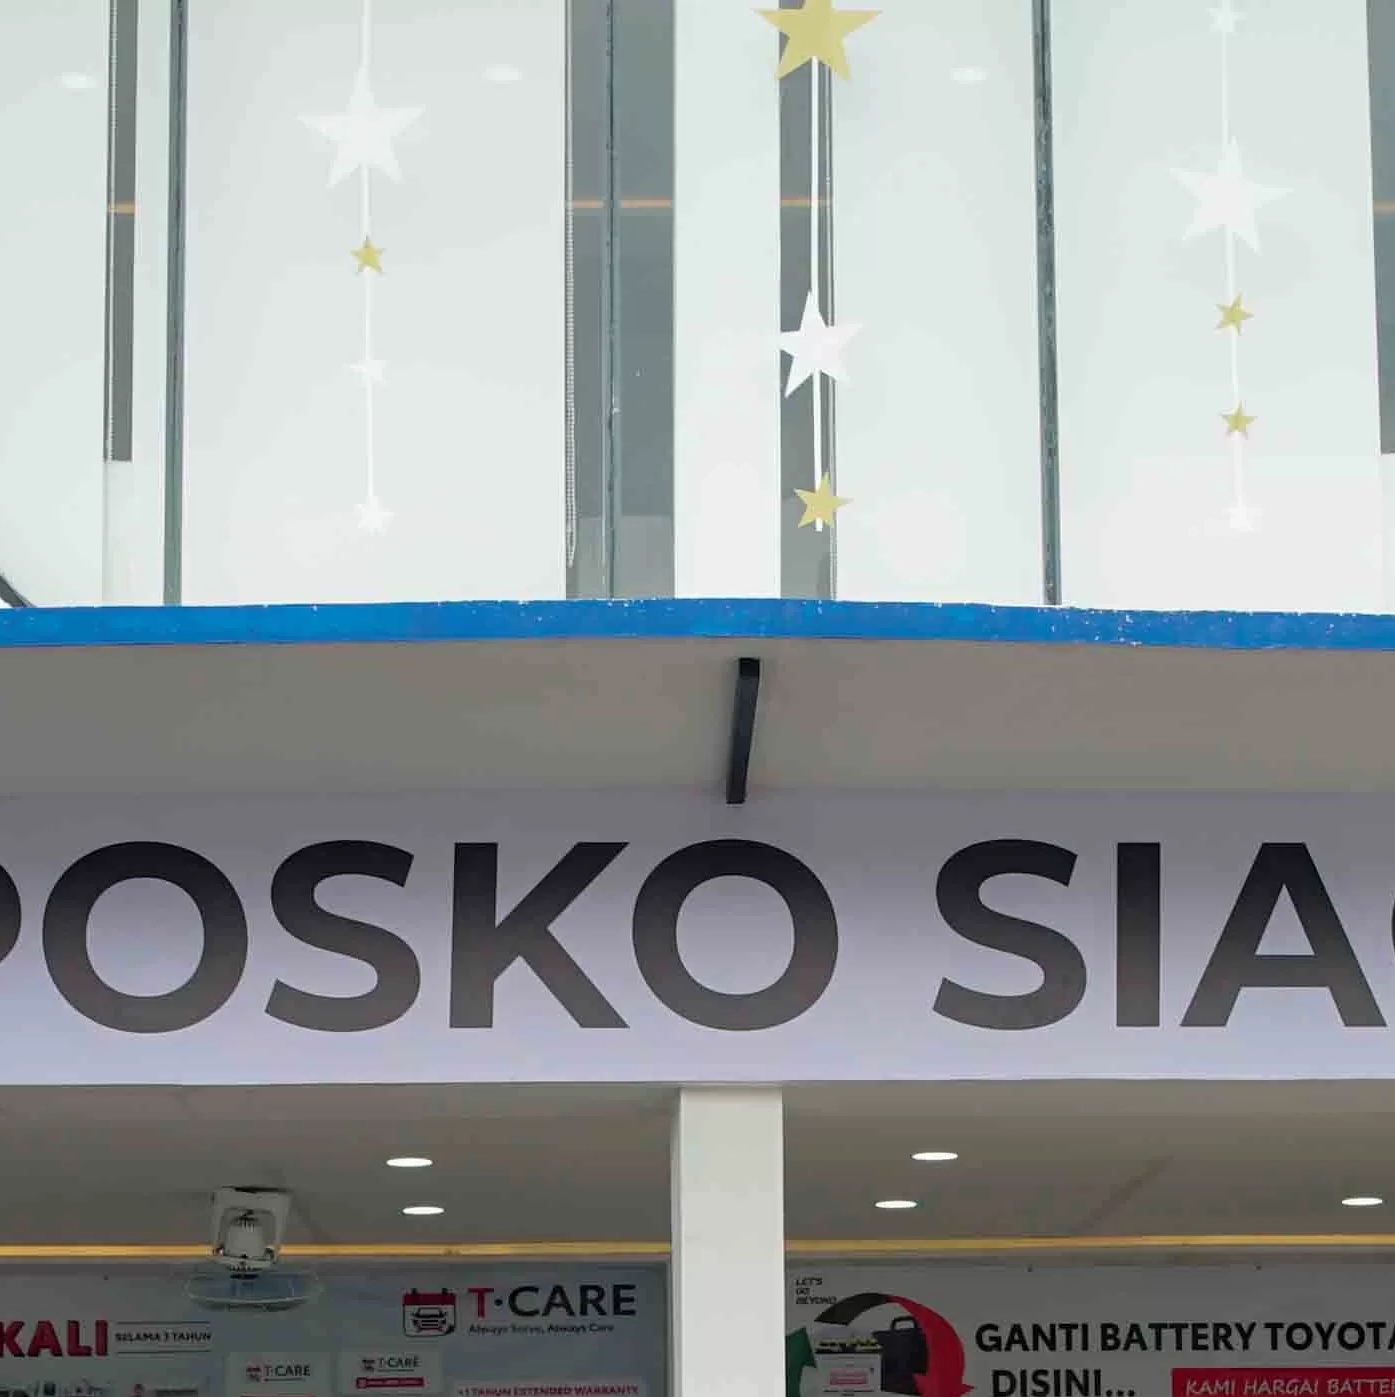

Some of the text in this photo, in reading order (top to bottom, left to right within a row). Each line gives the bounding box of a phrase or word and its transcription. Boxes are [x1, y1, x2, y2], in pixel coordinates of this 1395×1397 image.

[975, 1323, 1097, 1352] GANTI
[1100, 1322, 1256, 1351] BATTERY
[992, 1368, 1136, 1397] DISINI...
[1185, 1378, 1236, 1397] KAMI
[1243, 1378, 1319, 1397] HARGAI
